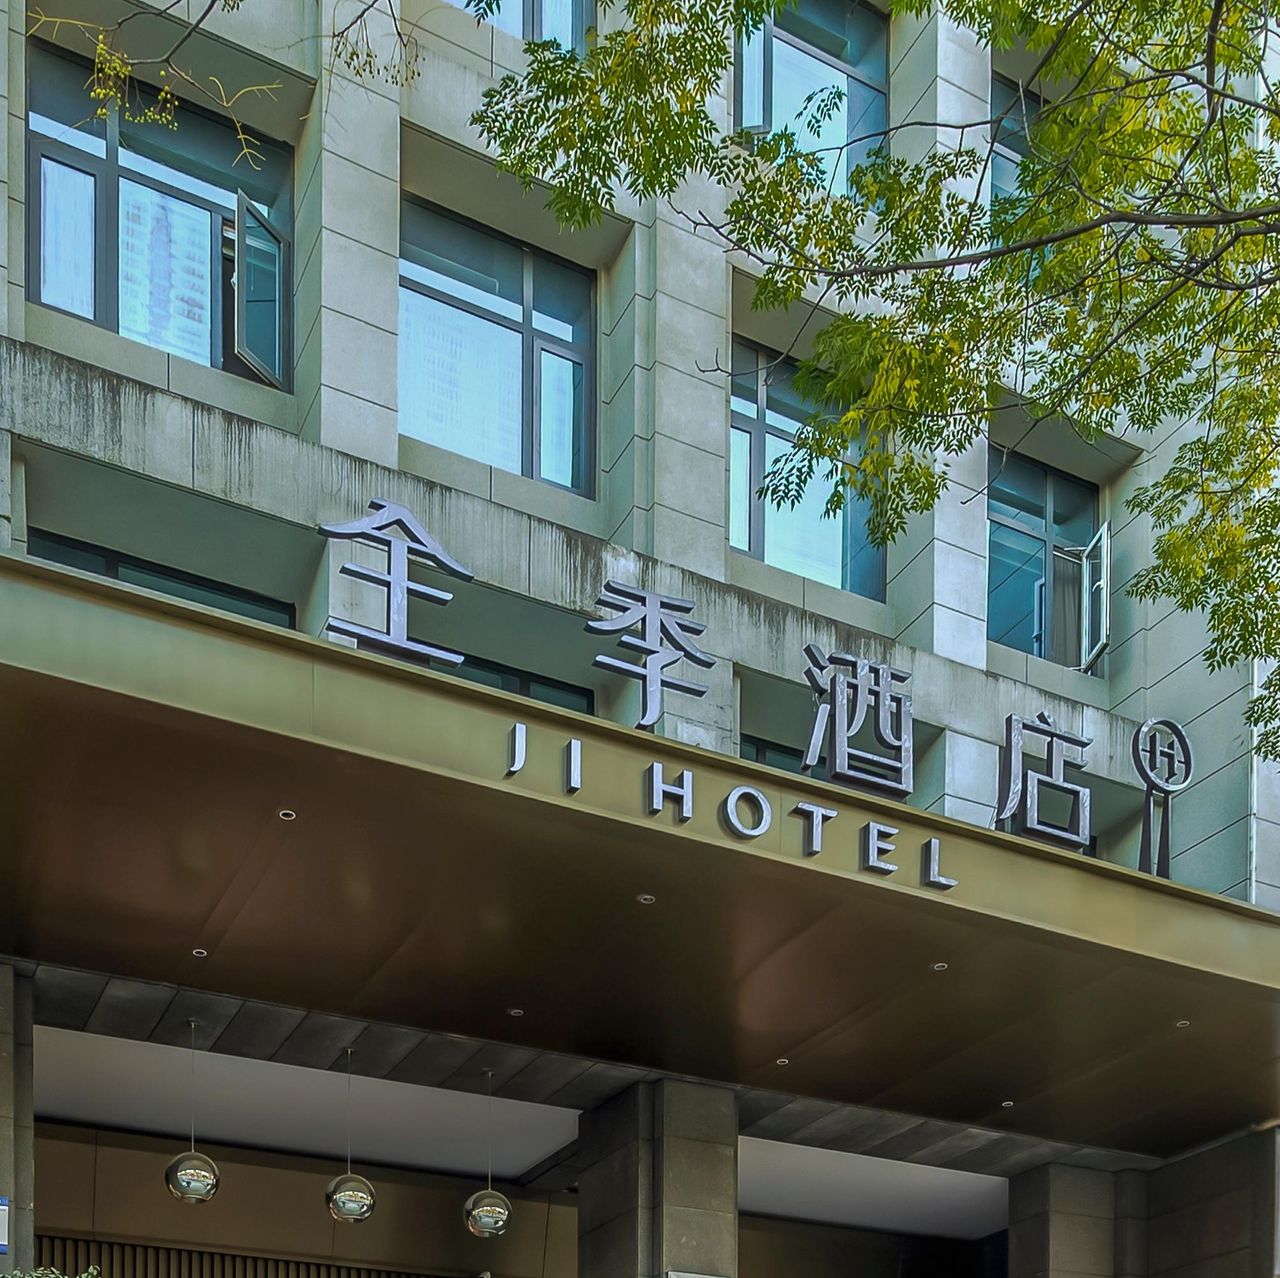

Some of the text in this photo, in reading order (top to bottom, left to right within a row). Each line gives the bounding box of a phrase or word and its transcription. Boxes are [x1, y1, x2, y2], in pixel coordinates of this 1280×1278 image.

[318, 497, 1093, 847] 全季酒店
[504, 722, 960, 891] JI HOTEL
